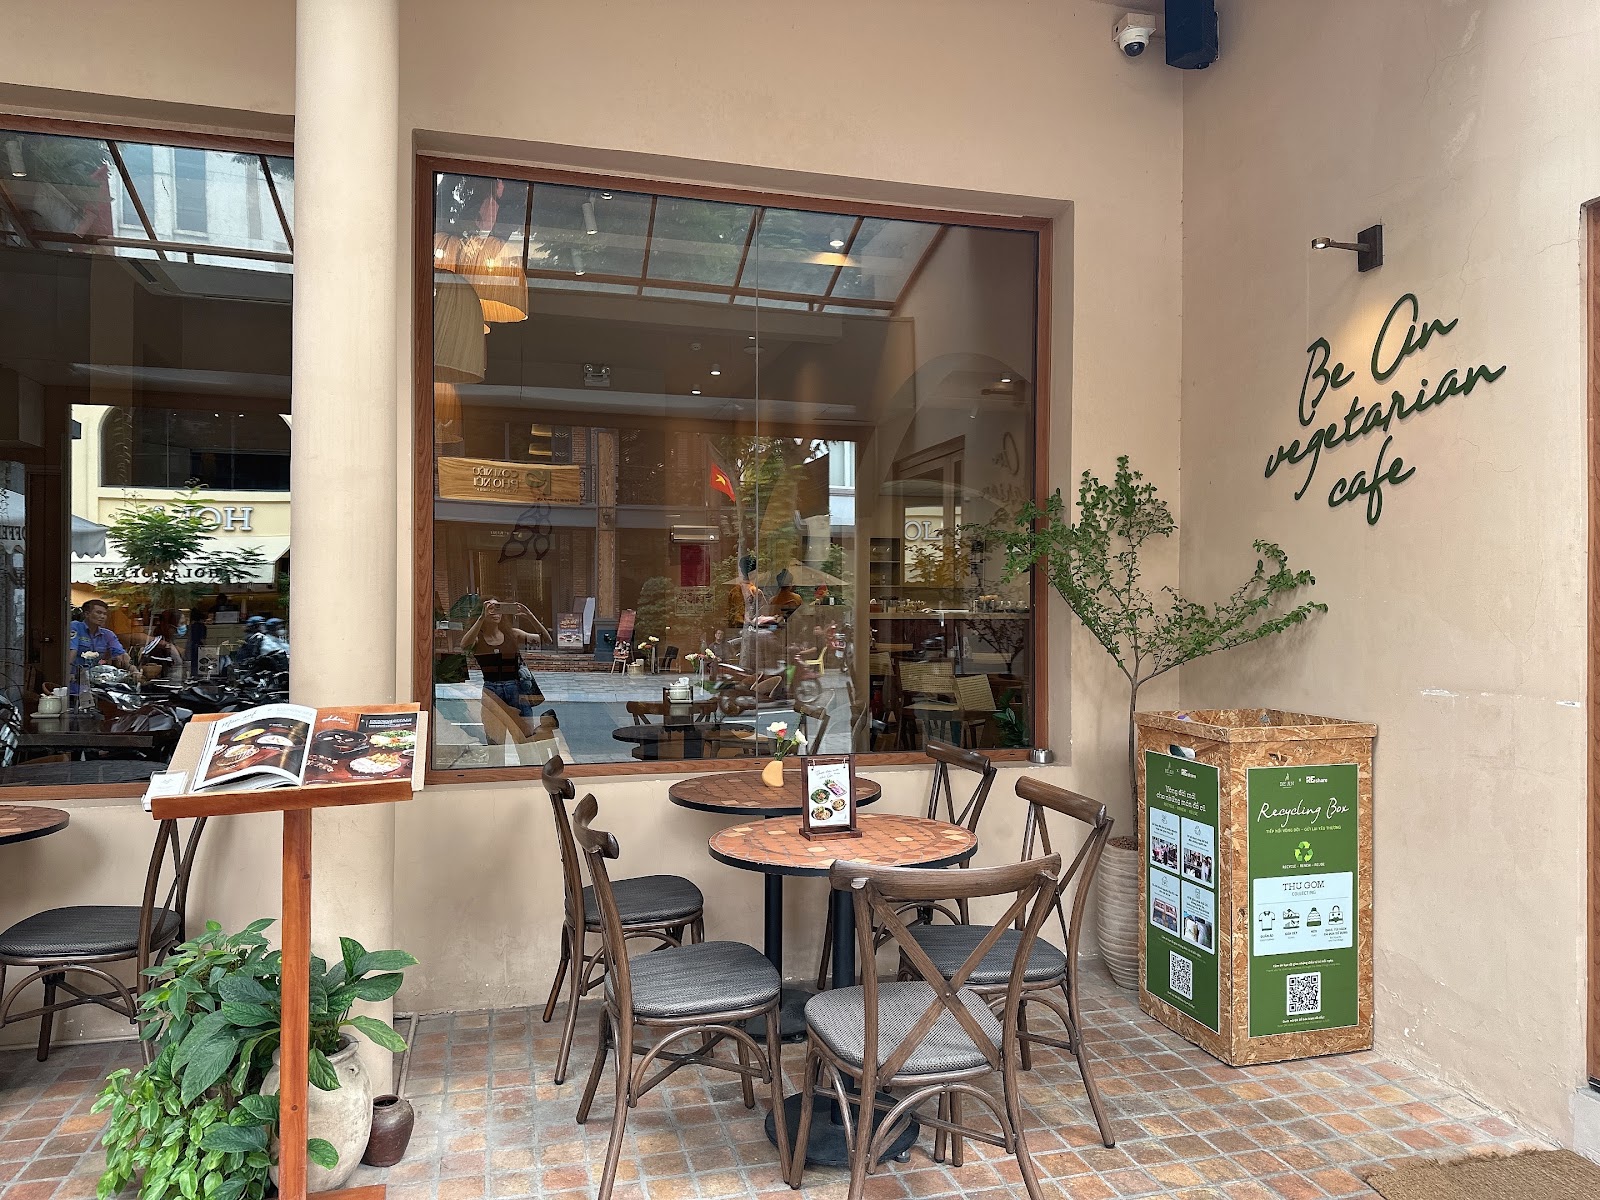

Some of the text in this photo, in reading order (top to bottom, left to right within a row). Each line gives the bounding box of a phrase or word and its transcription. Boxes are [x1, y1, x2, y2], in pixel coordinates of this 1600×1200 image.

[1298, 336, 1355, 427] Be
[1264, 364, 1507, 501] vegetarian
[1327, 435, 1416, 526] cafe
[1257, 797, 1350, 828] Recycling Box
[1282, 880, 1325, 891] THU GOM
